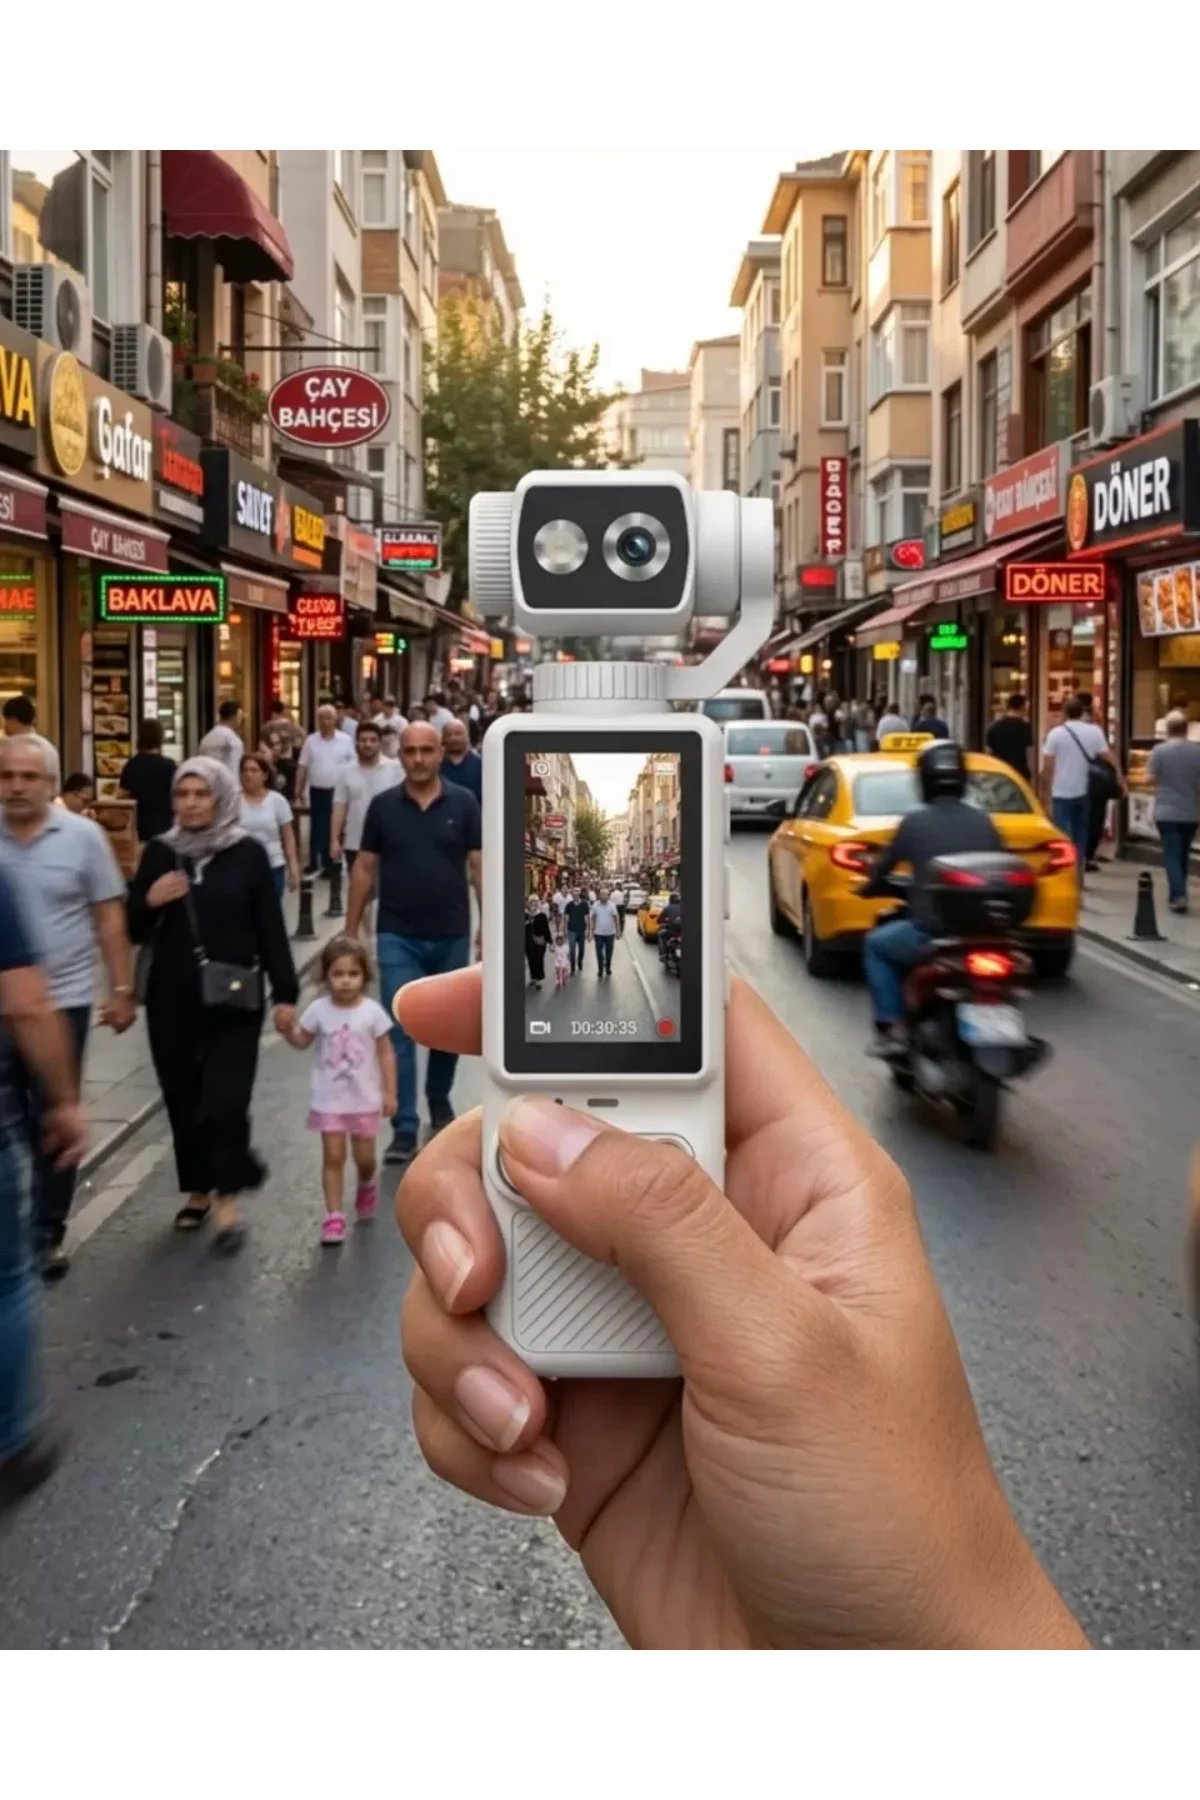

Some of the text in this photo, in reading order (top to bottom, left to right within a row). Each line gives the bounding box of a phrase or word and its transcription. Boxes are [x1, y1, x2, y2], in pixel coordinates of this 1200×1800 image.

[304, 377, 352, 403] ÇAY
[279, 402, 378, 434] BAHÇESİ
[1093, 456, 1171, 532] DÖNER
[1013, 567, 1101, 595] DÖNER
[108, 587, 217, 612] BAKLAVA
